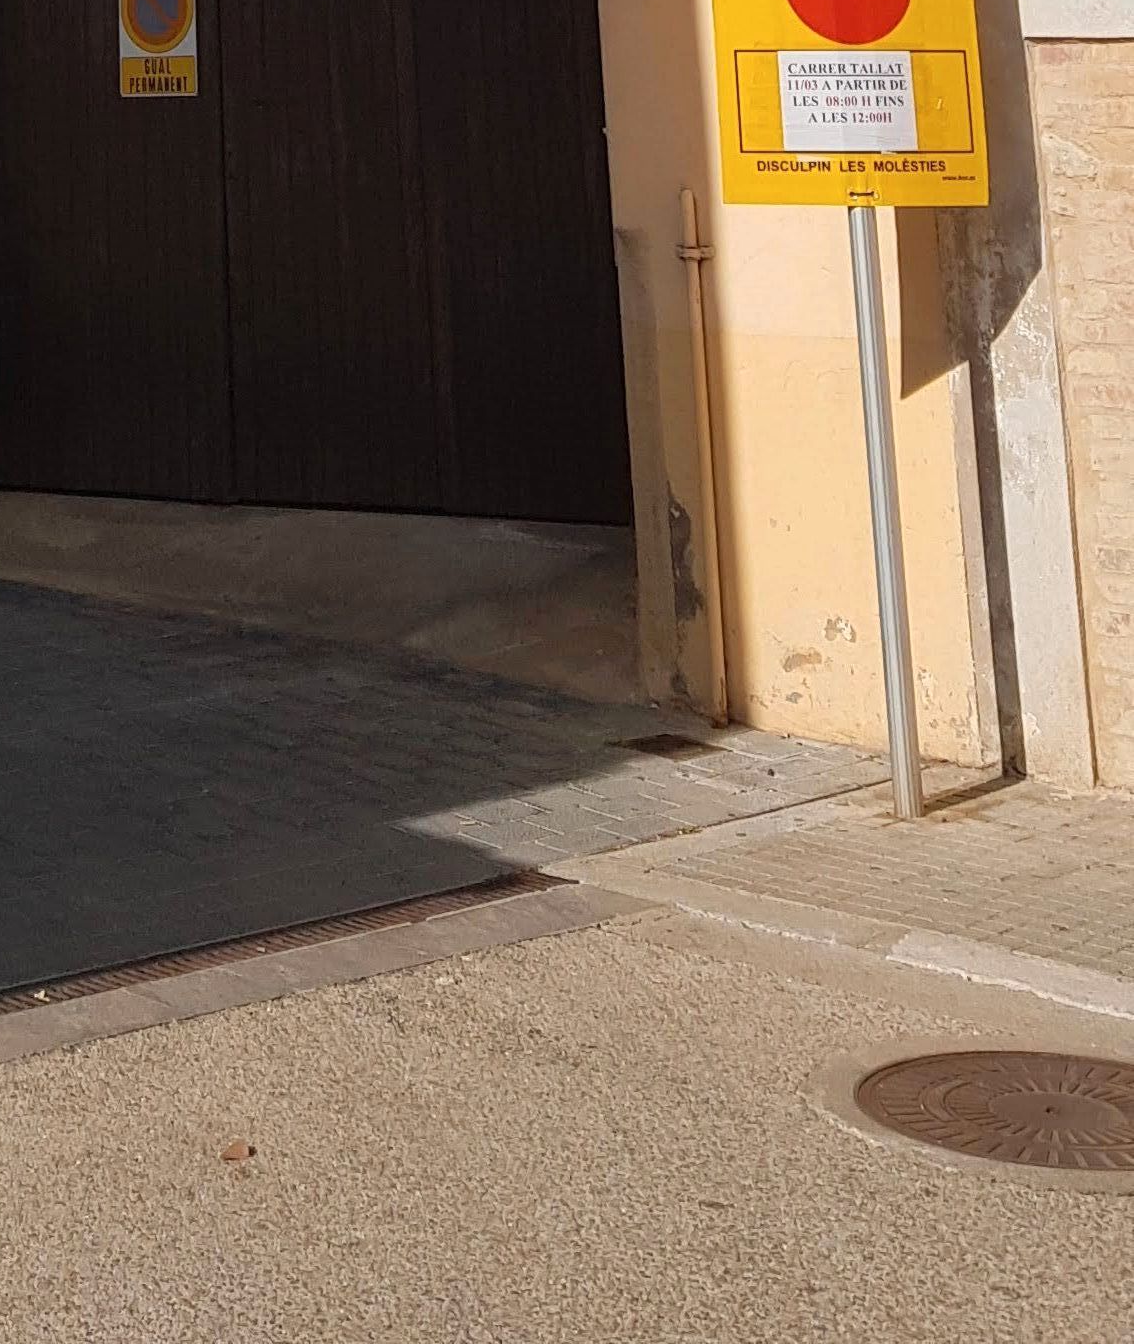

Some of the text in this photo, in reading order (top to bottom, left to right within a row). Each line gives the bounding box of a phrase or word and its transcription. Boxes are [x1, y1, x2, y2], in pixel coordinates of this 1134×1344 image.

[144, 58, 171, 75] GUAL
[787, 63, 904, 75] CARRER TALLAT
[129, 76, 188, 93] PERMANENT
[787, 79, 907, 91] 11/03 A PARTIR DE
[793, 95, 905, 107] LES 08:00 H FINS
[808, 112, 892, 123] A LES 12:00H
[757, 158, 946, 172] DISCULPIN LES MOLÈSTIES
